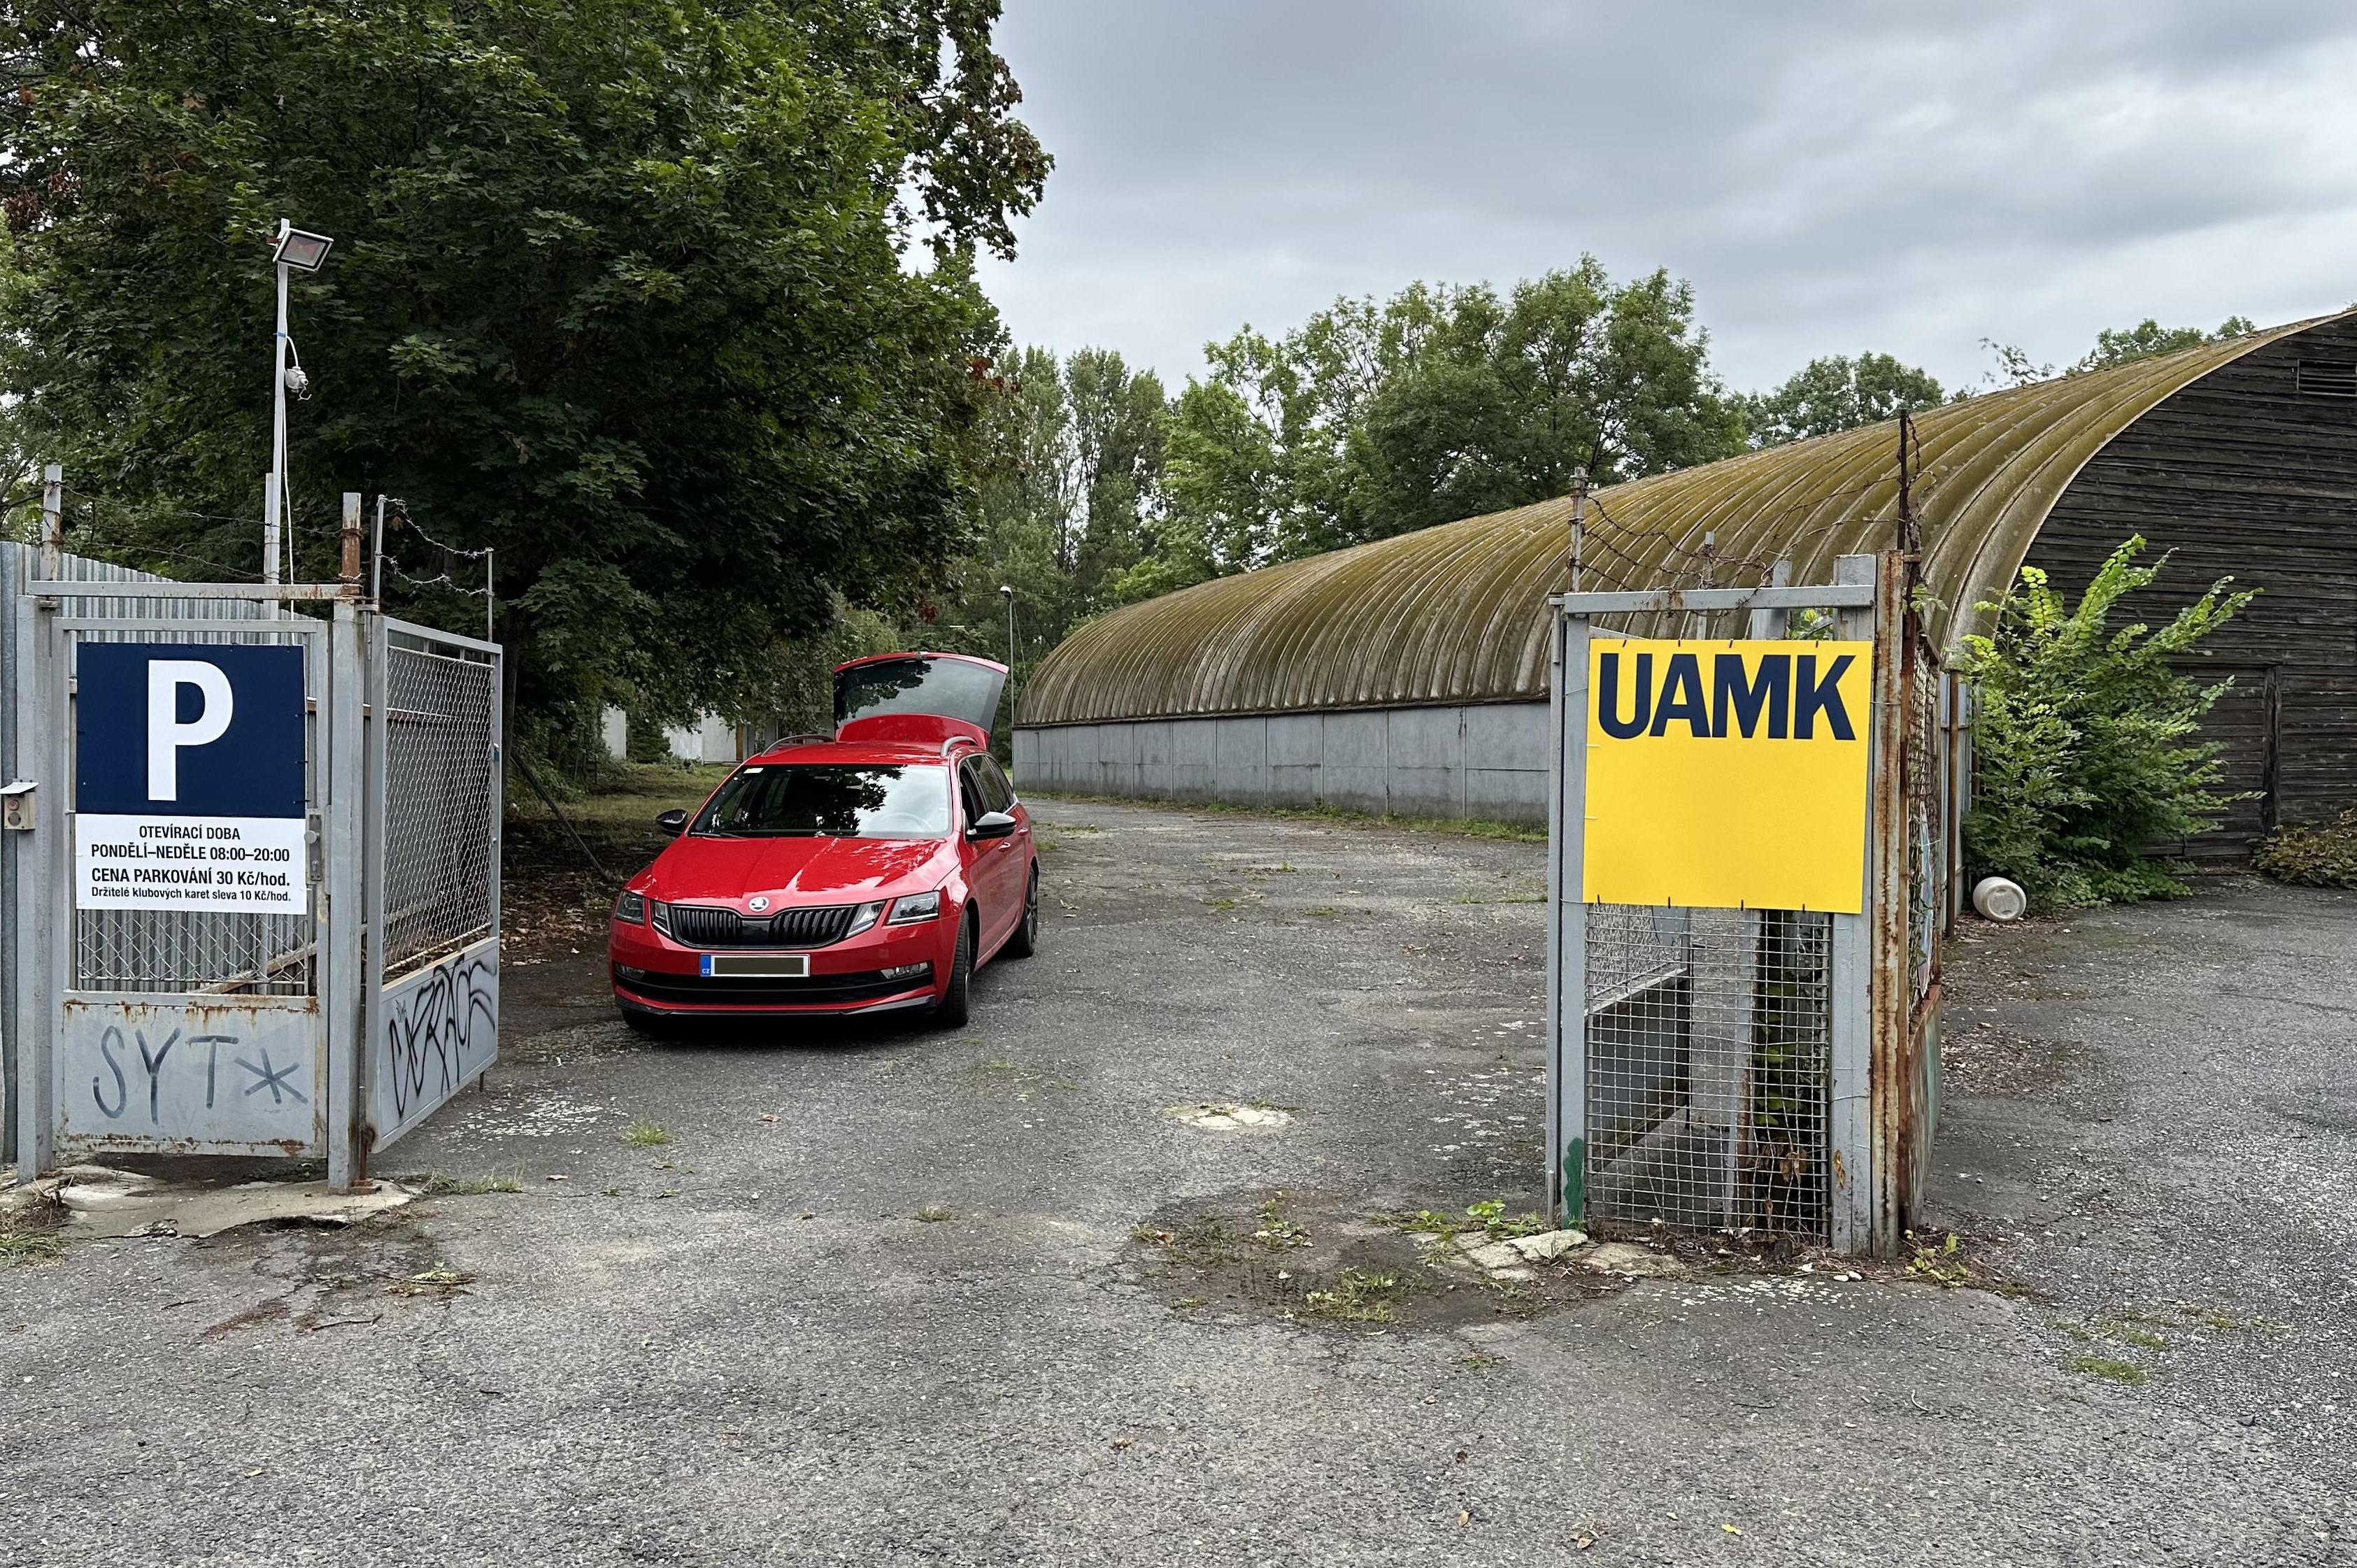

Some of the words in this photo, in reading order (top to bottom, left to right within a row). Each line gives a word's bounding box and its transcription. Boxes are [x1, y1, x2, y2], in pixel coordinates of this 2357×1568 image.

[1597, 653, 1856, 741] UAMK
[148, 660, 234, 801] P
[139, 823, 203, 839] OTEVÍRACÍ
[206, 827, 241, 840] DOBA
[92, 867, 130, 883] CENA
[134, 867, 213, 884] PARKOVÁNÍ
[216, 871, 233, 885] 30
[237, 871, 290, 886] Kč/hod.
[92, 886, 129, 897] Držitelé
[132, 887, 182, 900] klubových
[185, 888, 210, 899] karet
[212, 889, 237, 900] sleva
[240, 890, 252, 901] 10
[254, 890, 292, 902] Kč/hod.
